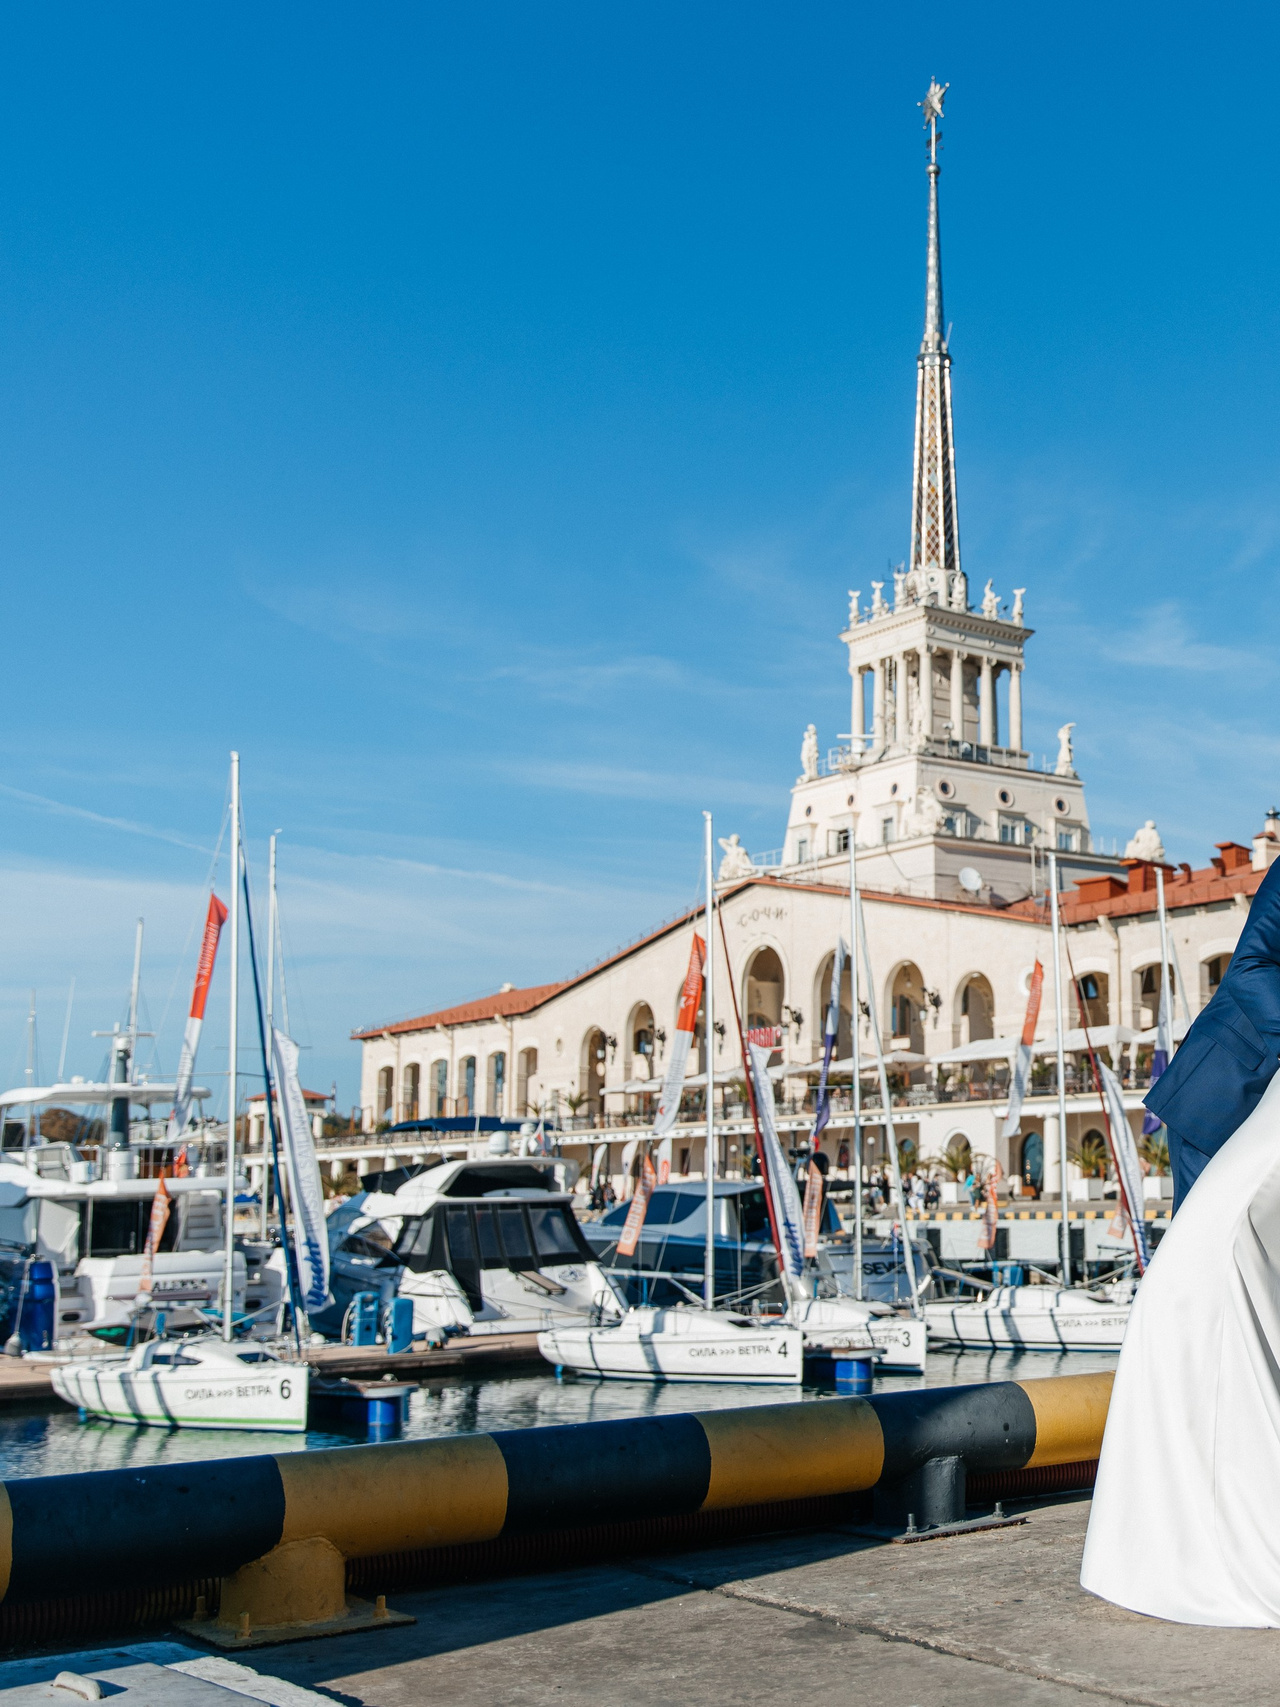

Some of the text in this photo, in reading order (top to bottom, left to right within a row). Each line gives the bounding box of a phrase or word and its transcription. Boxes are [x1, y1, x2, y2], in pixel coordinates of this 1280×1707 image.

[301, 1176, 321, 1232] RUSSIA
[302, 1237, 327, 1307] Yacht
[902, 1331, 911, 1347] 3
[688, 1345, 772, 1357] СИЛА ВЕТРА
[777, 1341, 788, 1358] 4
[184, 1385, 273, 1399] СИЛА ВЕТРА
[279, 1379, 291, 1399] 6
